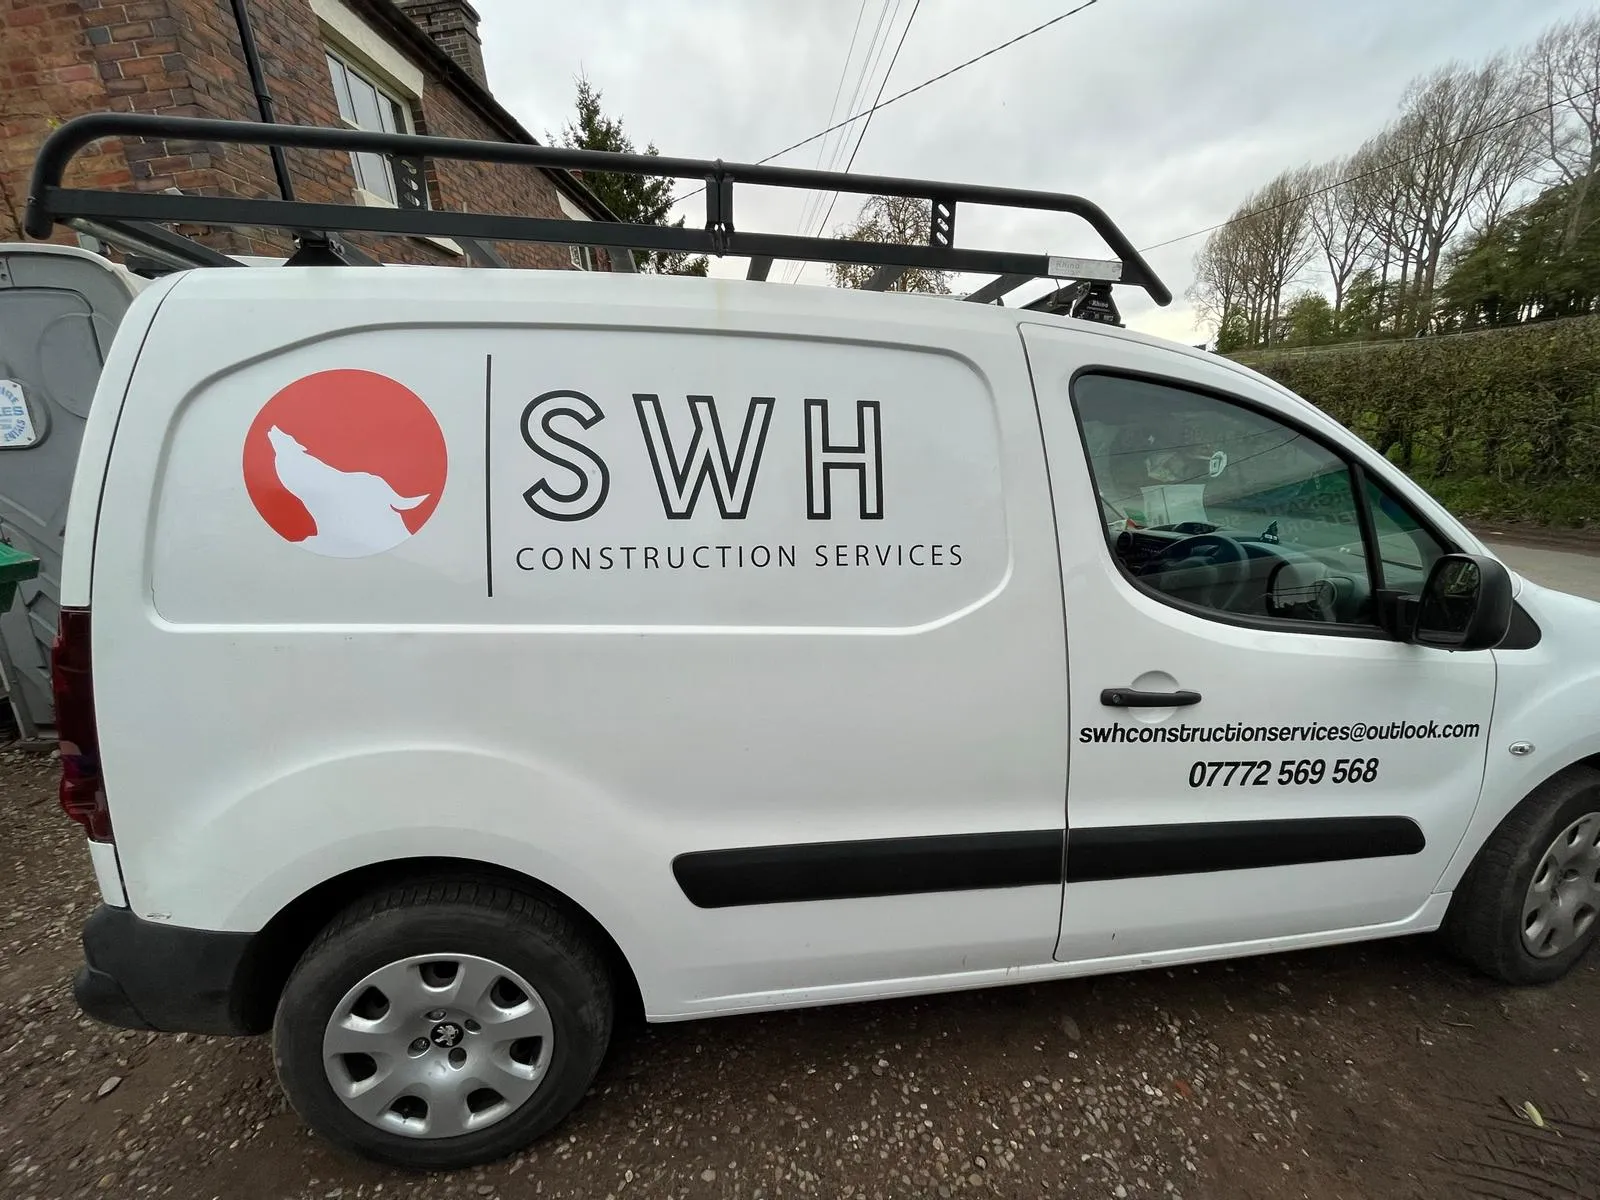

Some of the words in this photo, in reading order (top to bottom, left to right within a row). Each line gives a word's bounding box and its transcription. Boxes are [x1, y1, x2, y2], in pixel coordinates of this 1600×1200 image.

[519, 389, 884, 522] SWH
[516, 545, 796, 571] CONSTRUCTION
[815, 544, 962, 567] SERVICES
[1079, 720, 1480, 744] swhconstructionservices@outlook.com
[1188, 760, 1272, 788] 07772
[1277, 758, 1326, 786] 569
[1331, 757, 1379, 784] 568
